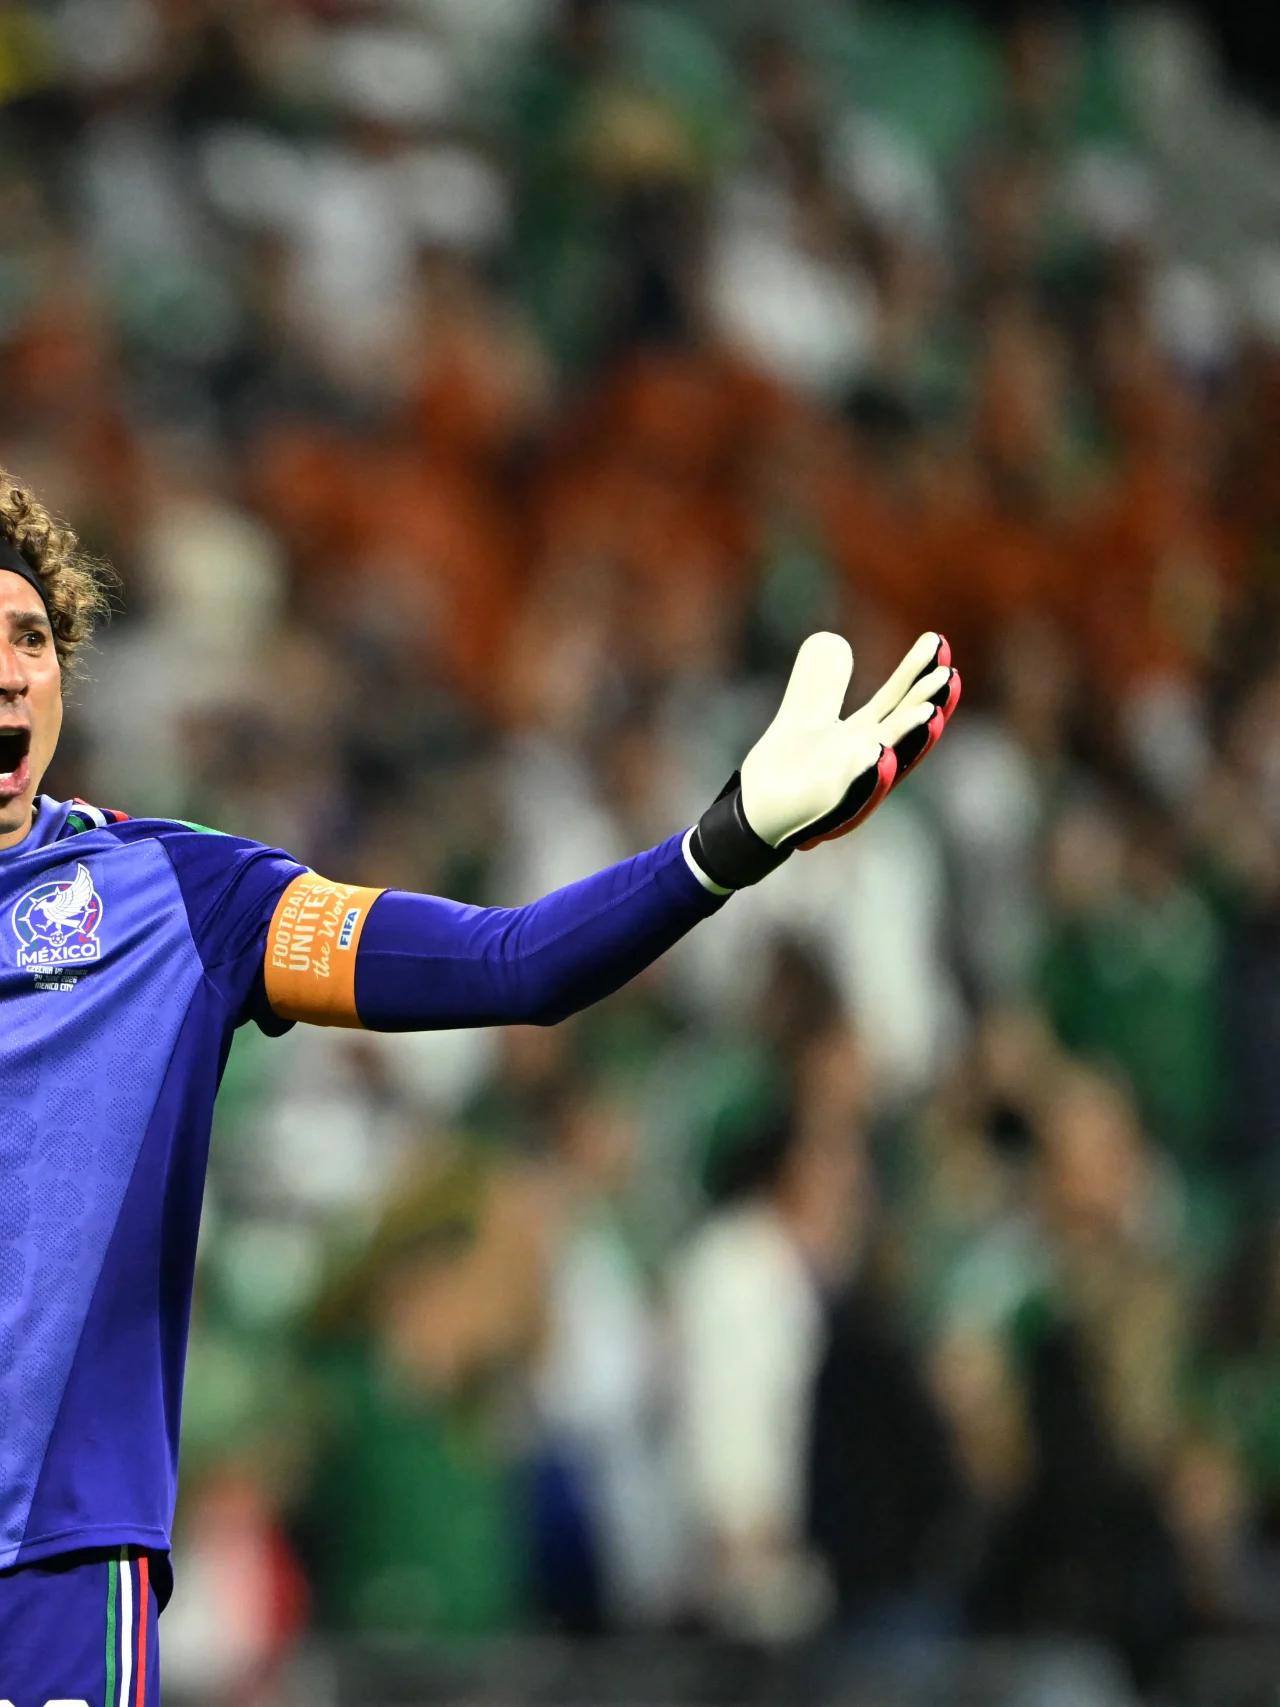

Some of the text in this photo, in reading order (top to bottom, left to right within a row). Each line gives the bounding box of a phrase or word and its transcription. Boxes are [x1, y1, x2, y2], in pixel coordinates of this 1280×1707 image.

[21, 943, 96, 966] MÉXICO
[272, 883, 314, 969] FOOTBALL
[288, 884, 336, 972] UNITES
[311, 884, 360, 980] the World
[339, 910, 358, 947] FIFA
